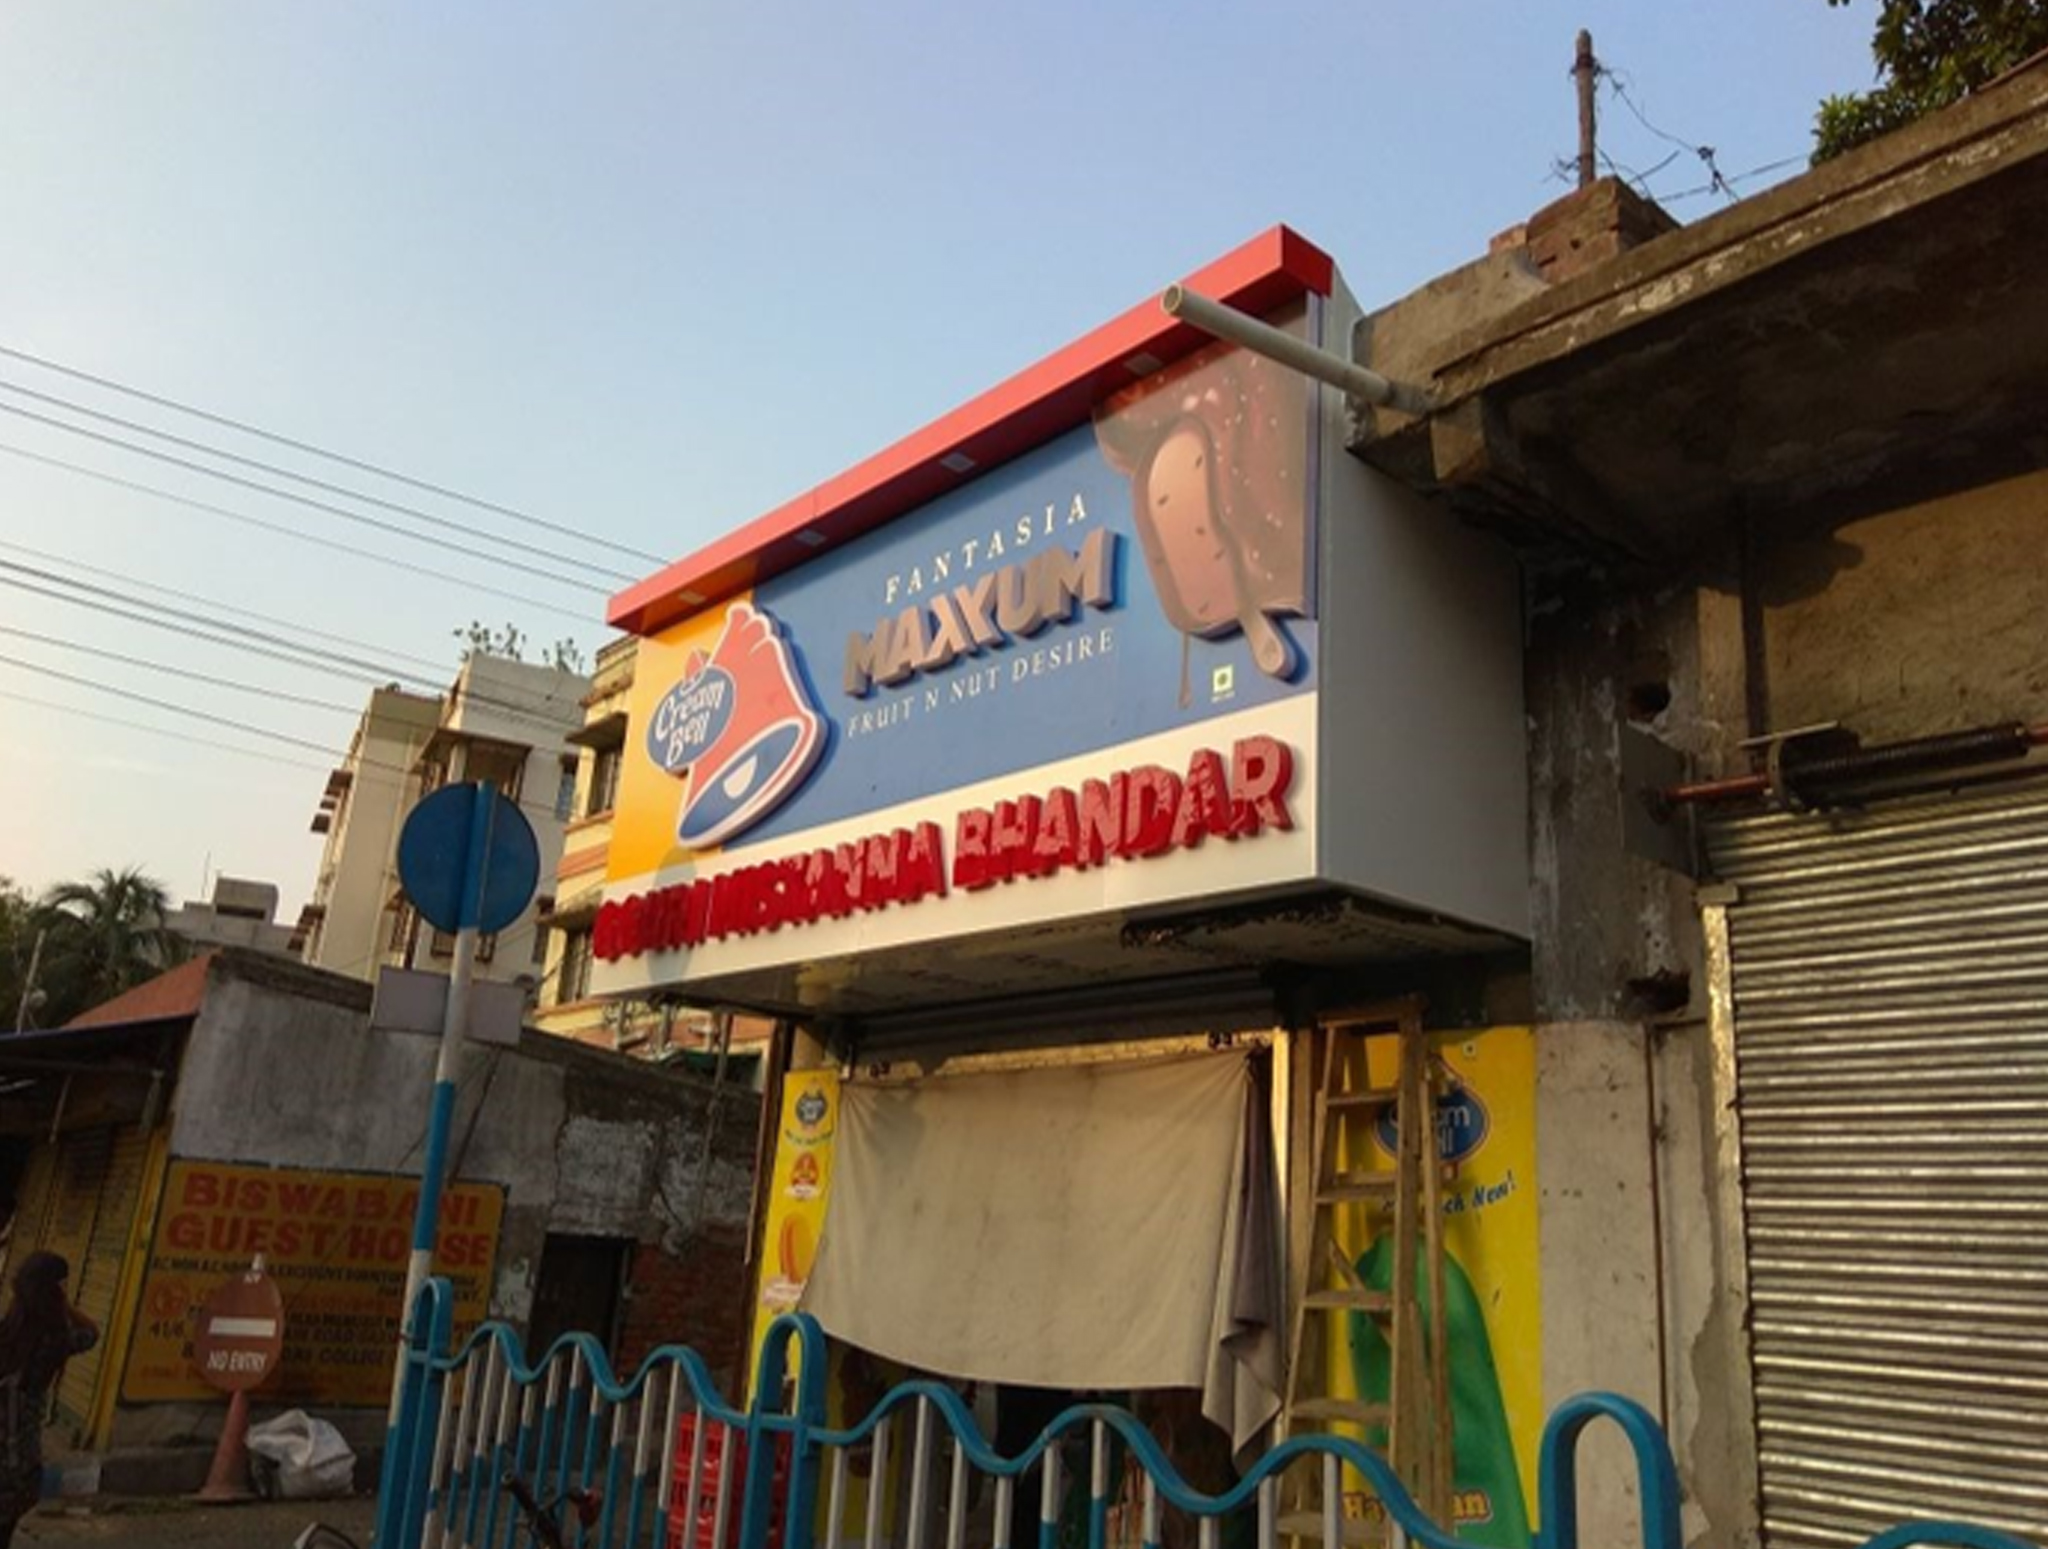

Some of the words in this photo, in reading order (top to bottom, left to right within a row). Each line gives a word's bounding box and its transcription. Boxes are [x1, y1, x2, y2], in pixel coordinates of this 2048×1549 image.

[884, 492, 1087, 605] FANTASIA
[842, 526, 1122, 698] MAXXUM
[655, 679, 726, 742] Cream
[847, 701, 912, 739] FRUIT
[924, 689, 941, 712] N
[949, 667, 1002, 703] NUT
[1012, 628, 1117, 682] DESIRE
[951, 733, 1296, 890] BHANDAR
[167, 1210, 336, 1258] GUEST
[346, 1226, 491, 1268] HOSE
[206, 1349, 229, 1371] NO
[229, 1350, 268, 1373] ENTRY
